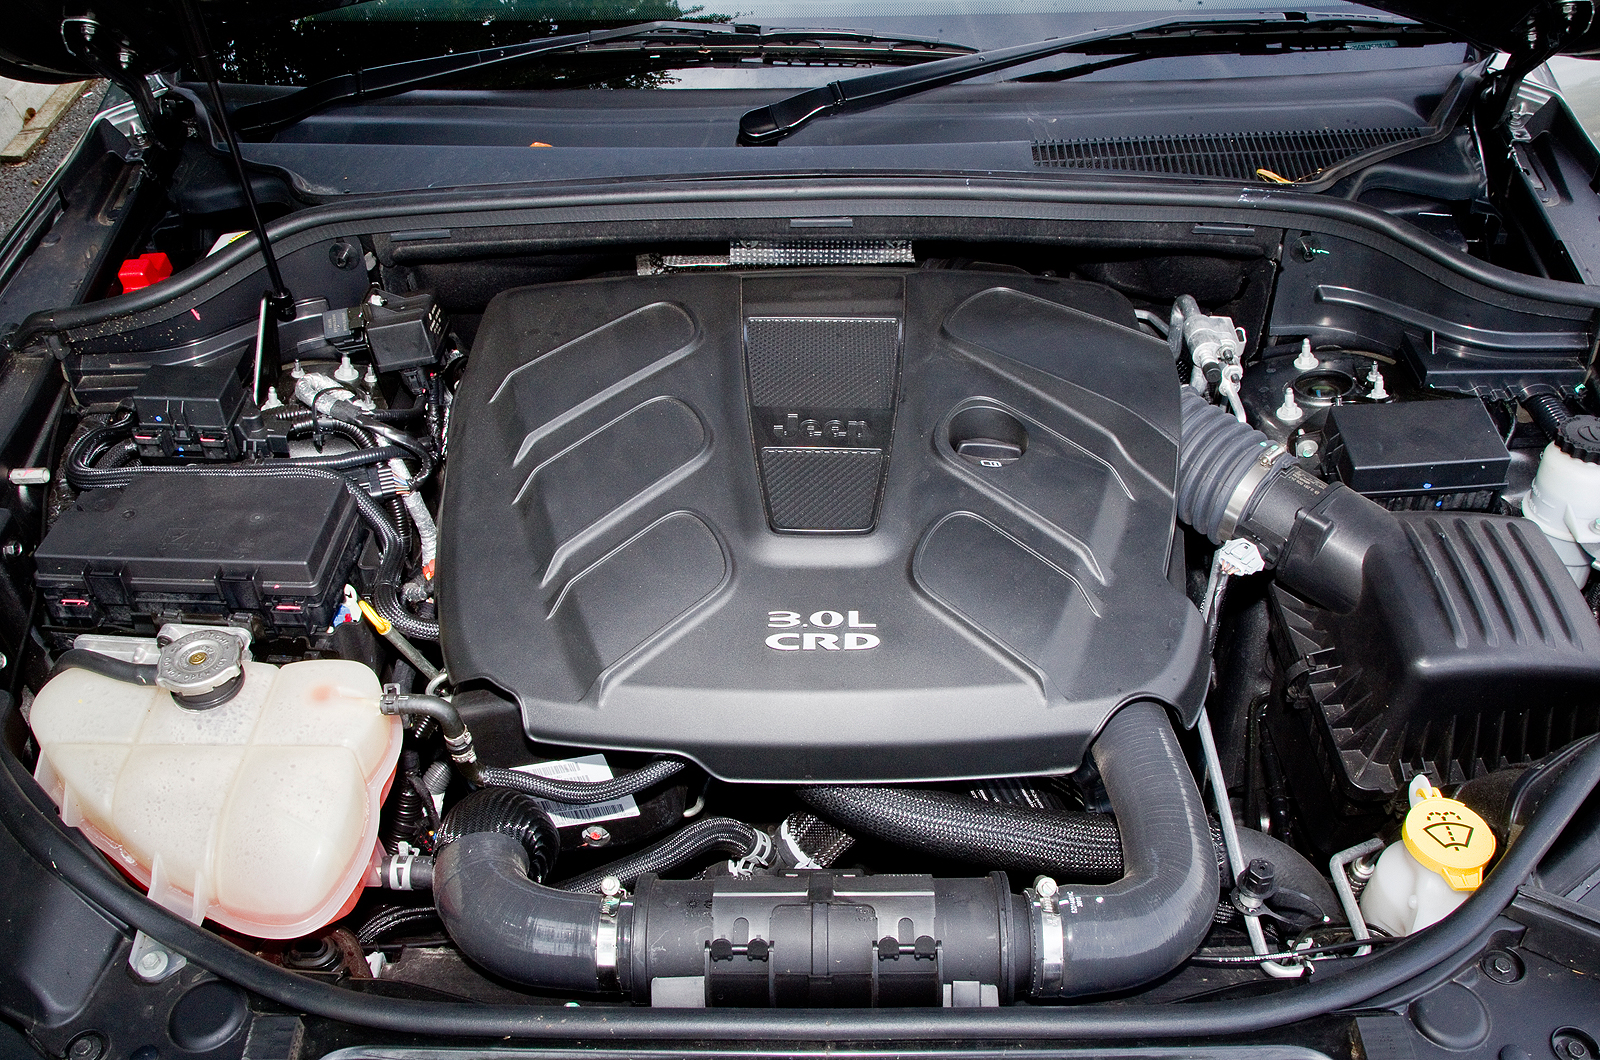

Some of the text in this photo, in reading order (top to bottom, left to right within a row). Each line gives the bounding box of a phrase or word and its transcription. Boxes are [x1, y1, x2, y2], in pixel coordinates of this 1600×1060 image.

[773, 413, 872, 445] Jeep
[767, 610, 877, 628] 3.0L
[765, 632, 881, 651] CRD
